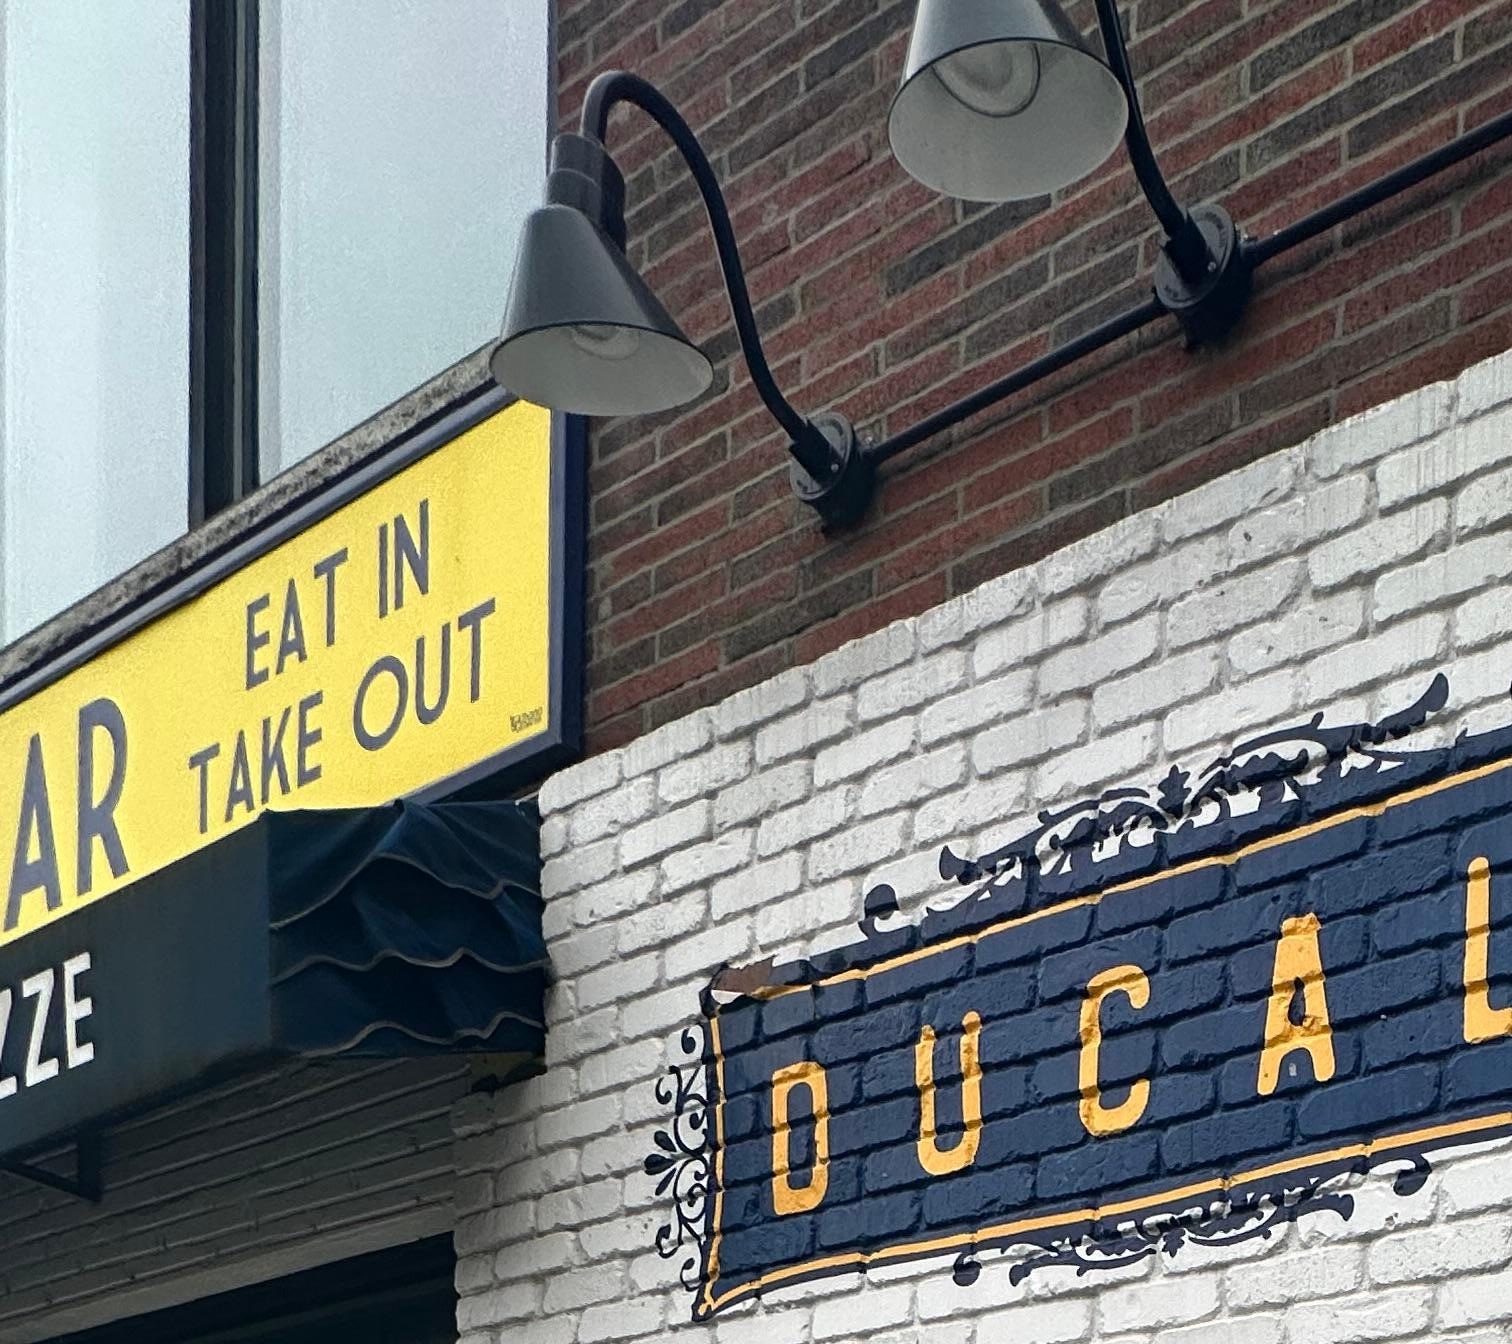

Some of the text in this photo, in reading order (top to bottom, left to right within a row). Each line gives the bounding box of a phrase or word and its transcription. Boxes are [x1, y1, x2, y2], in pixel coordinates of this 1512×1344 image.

[244, 497, 431, 691] EAT IN
[3, 695, 131, 932] AR
[188, 597, 497, 835] TAKE OUT
